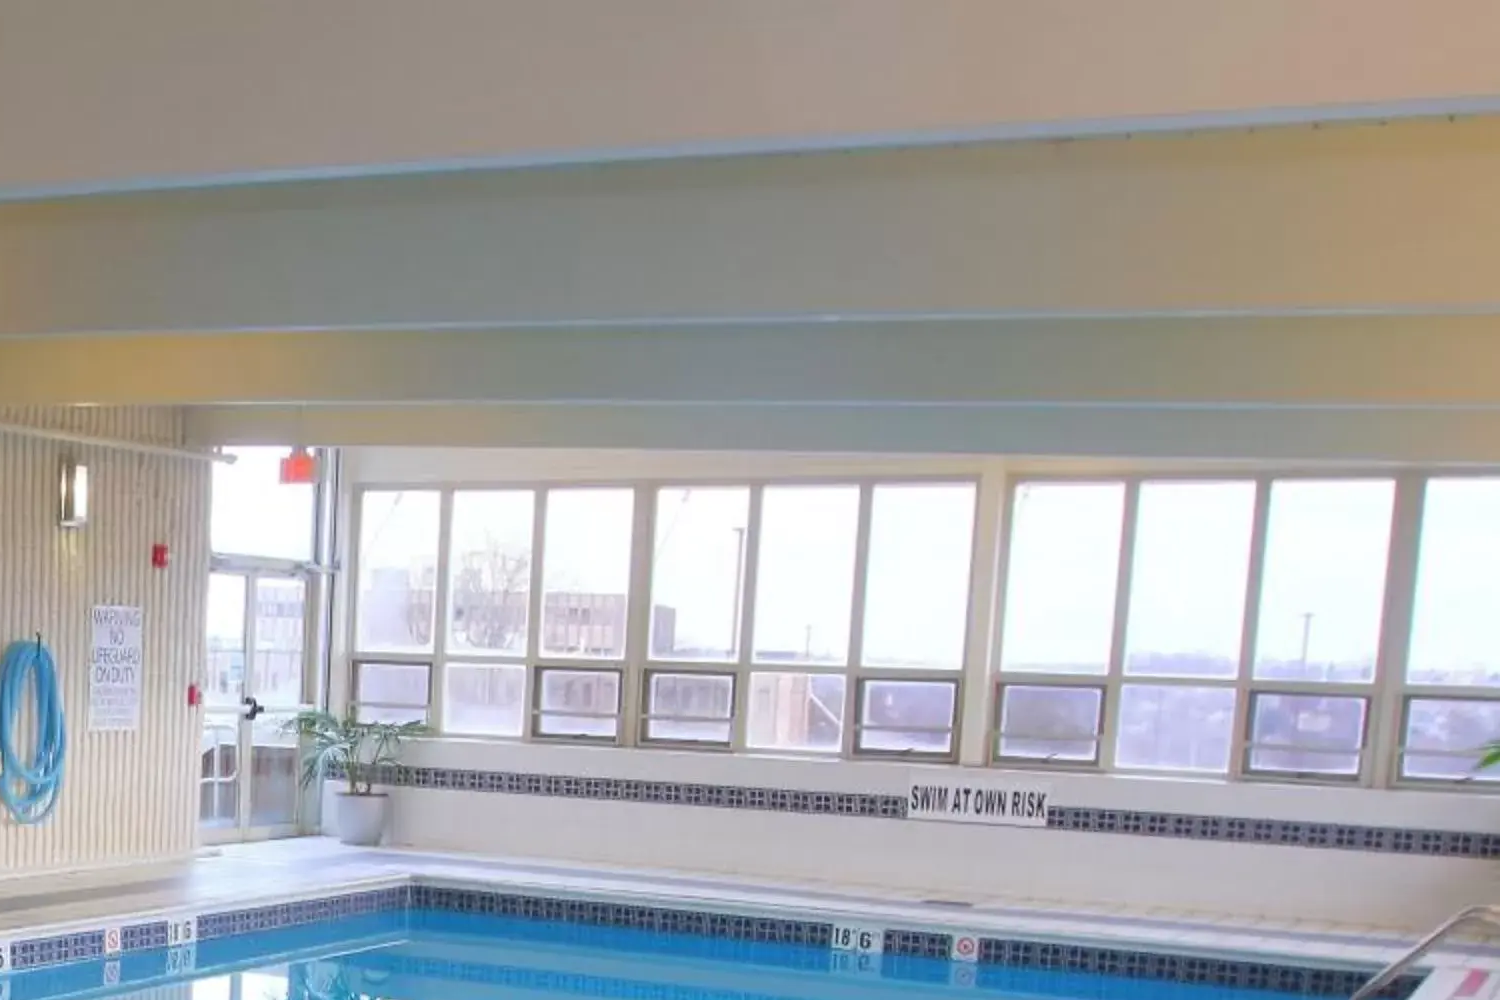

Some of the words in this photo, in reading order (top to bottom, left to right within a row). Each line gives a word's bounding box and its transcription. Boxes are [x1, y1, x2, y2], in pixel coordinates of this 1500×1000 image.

[109, 629, 125, 646] NO
[911, 785, 948, 812] SWIM
[952, 787, 972, 814] AT
[974, 789, 1007, 816] OWN
[1012, 791, 1047, 818] RISK
[834, 926, 851, 946] 18
[859, 931, 872, 949] 6
